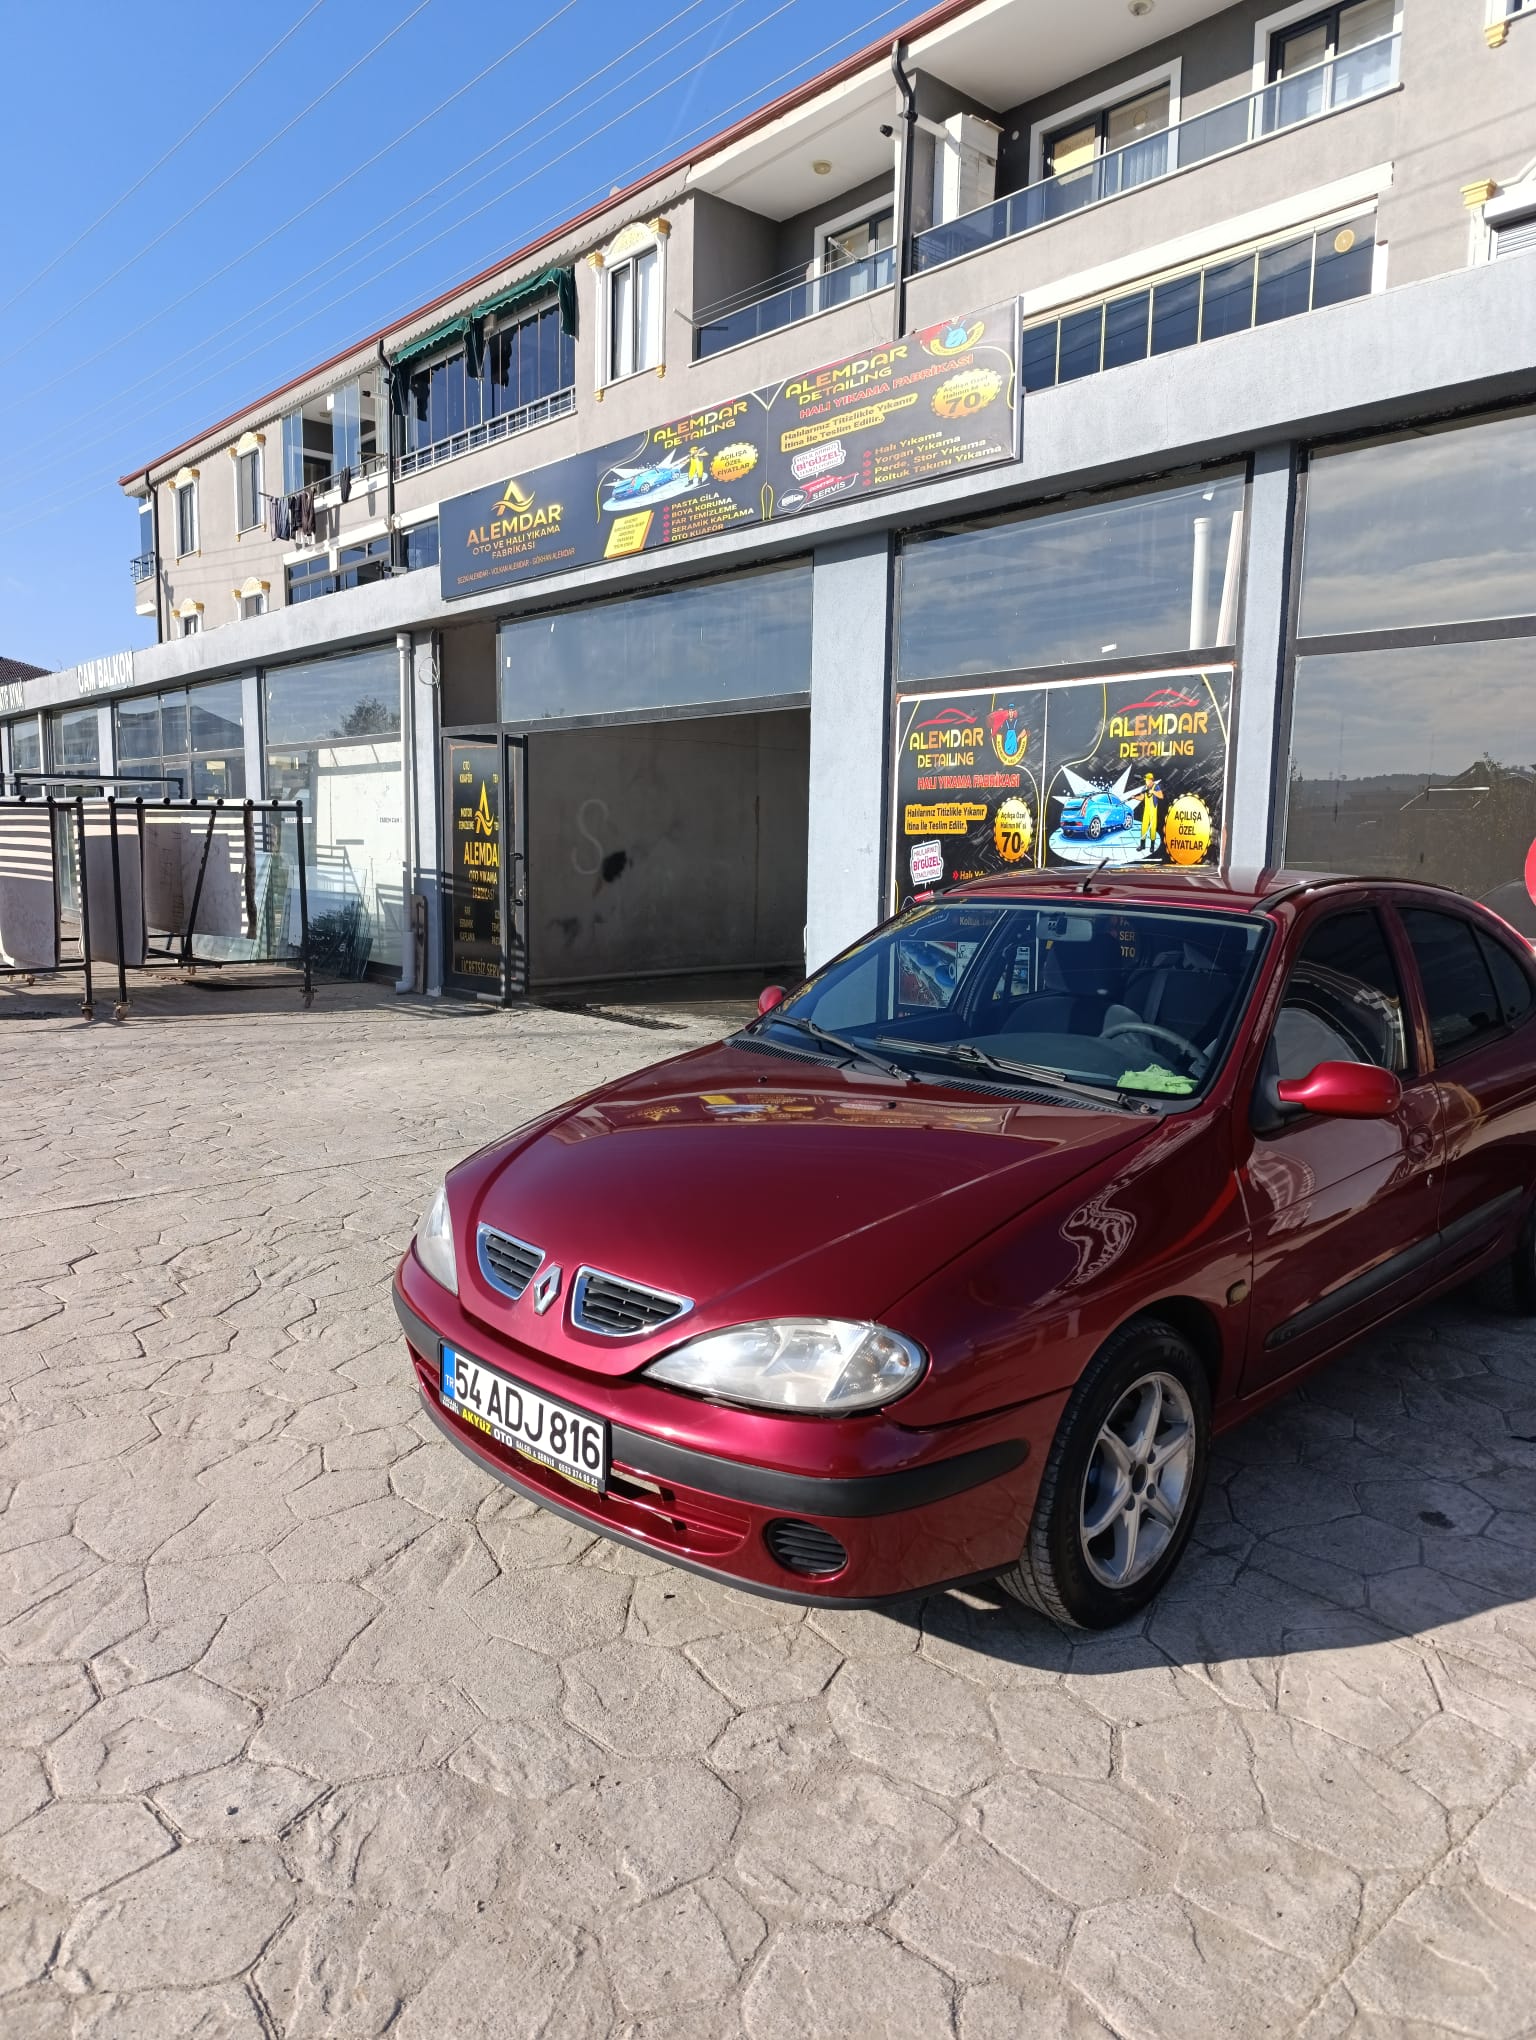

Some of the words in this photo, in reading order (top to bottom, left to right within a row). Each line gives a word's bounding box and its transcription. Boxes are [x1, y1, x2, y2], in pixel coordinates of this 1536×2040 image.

[785, 345, 908, 398] ALEMDAR
[799, 401, 831, 419] HALI
[833, 382, 890, 408] YIKAMA
[892, 352, 974, 389] FABRİKASI
[799, 366, 892, 406] DETAILING
[654, 401, 748, 443] ALEMDAR
[664, 419, 736, 449] DETAILING
[874, 443, 897, 455] Halı
[899, 431, 943, 449] Yıkama
[874, 448, 914, 465] Yorgan
[917, 435, 961, 454] Yıkama
[913, 451, 938, 464] Stor
[940, 438, 986, 458] Yıkama
[720, 449, 748, 462] AÇILIŞA
[724, 457, 742, 468] ÖZEL
[874, 469, 910, 484] Koltuk
[914, 459, 952, 473] Takımı
[955, 445, 1002, 463] Yıkama
[671, 498, 698, 510] PASTA
[700, 492, 719, 504] CİLA
[671, 507, 694, 518] BOYA
[695, 497, 733, 512] KORUMA
[466, 504, 561, 547] ALEMDAR
[671, 516, 687, 526] FAR
[689, 503, 738, 522] TEMİZLEME
[710, 508, 755, 525] KAPLAMA
[472, 543, 492, 556] OTO
[493, 540, 505, 550] VE
[506, 535, 525, 547] HALI
[527, 524, 561, 540] YIKAMA
[671, 533, 688, 542] OTO
[77, 661, 96, 694] CAM
[98, 651, 134, 689] BALKON
[1109, 712, 1208, 738] ALEMDAR
[909, 727, 984, 751] ALEMDAR
[1119, 740, 1194, 758] DETAILING
[917, 751, 974, 769] DETAILING
[917, 777, 937, 790] HALI
[938, 774, 972, 789] YIKAMA
[929, 821, 948, 830] Teslim
[1174, 810, 1202, 823] AÇILIŞA
[1178, 824, 1196, 836] ÖZEL
[463, 841, 500, 868] ALEMDA
[1170, 839, 1203, 851] FİYATLAR
[445, 1374, 455, 1388] TR
[455, 1357, 482, 1410] 54
[487, 1379, 544, 1442] ADJ
[550, 1411, 600, 1470] 816
[462, 1408, 492, 1436] AKYÜZ
[493, 1428, 513, 1447] OTO
